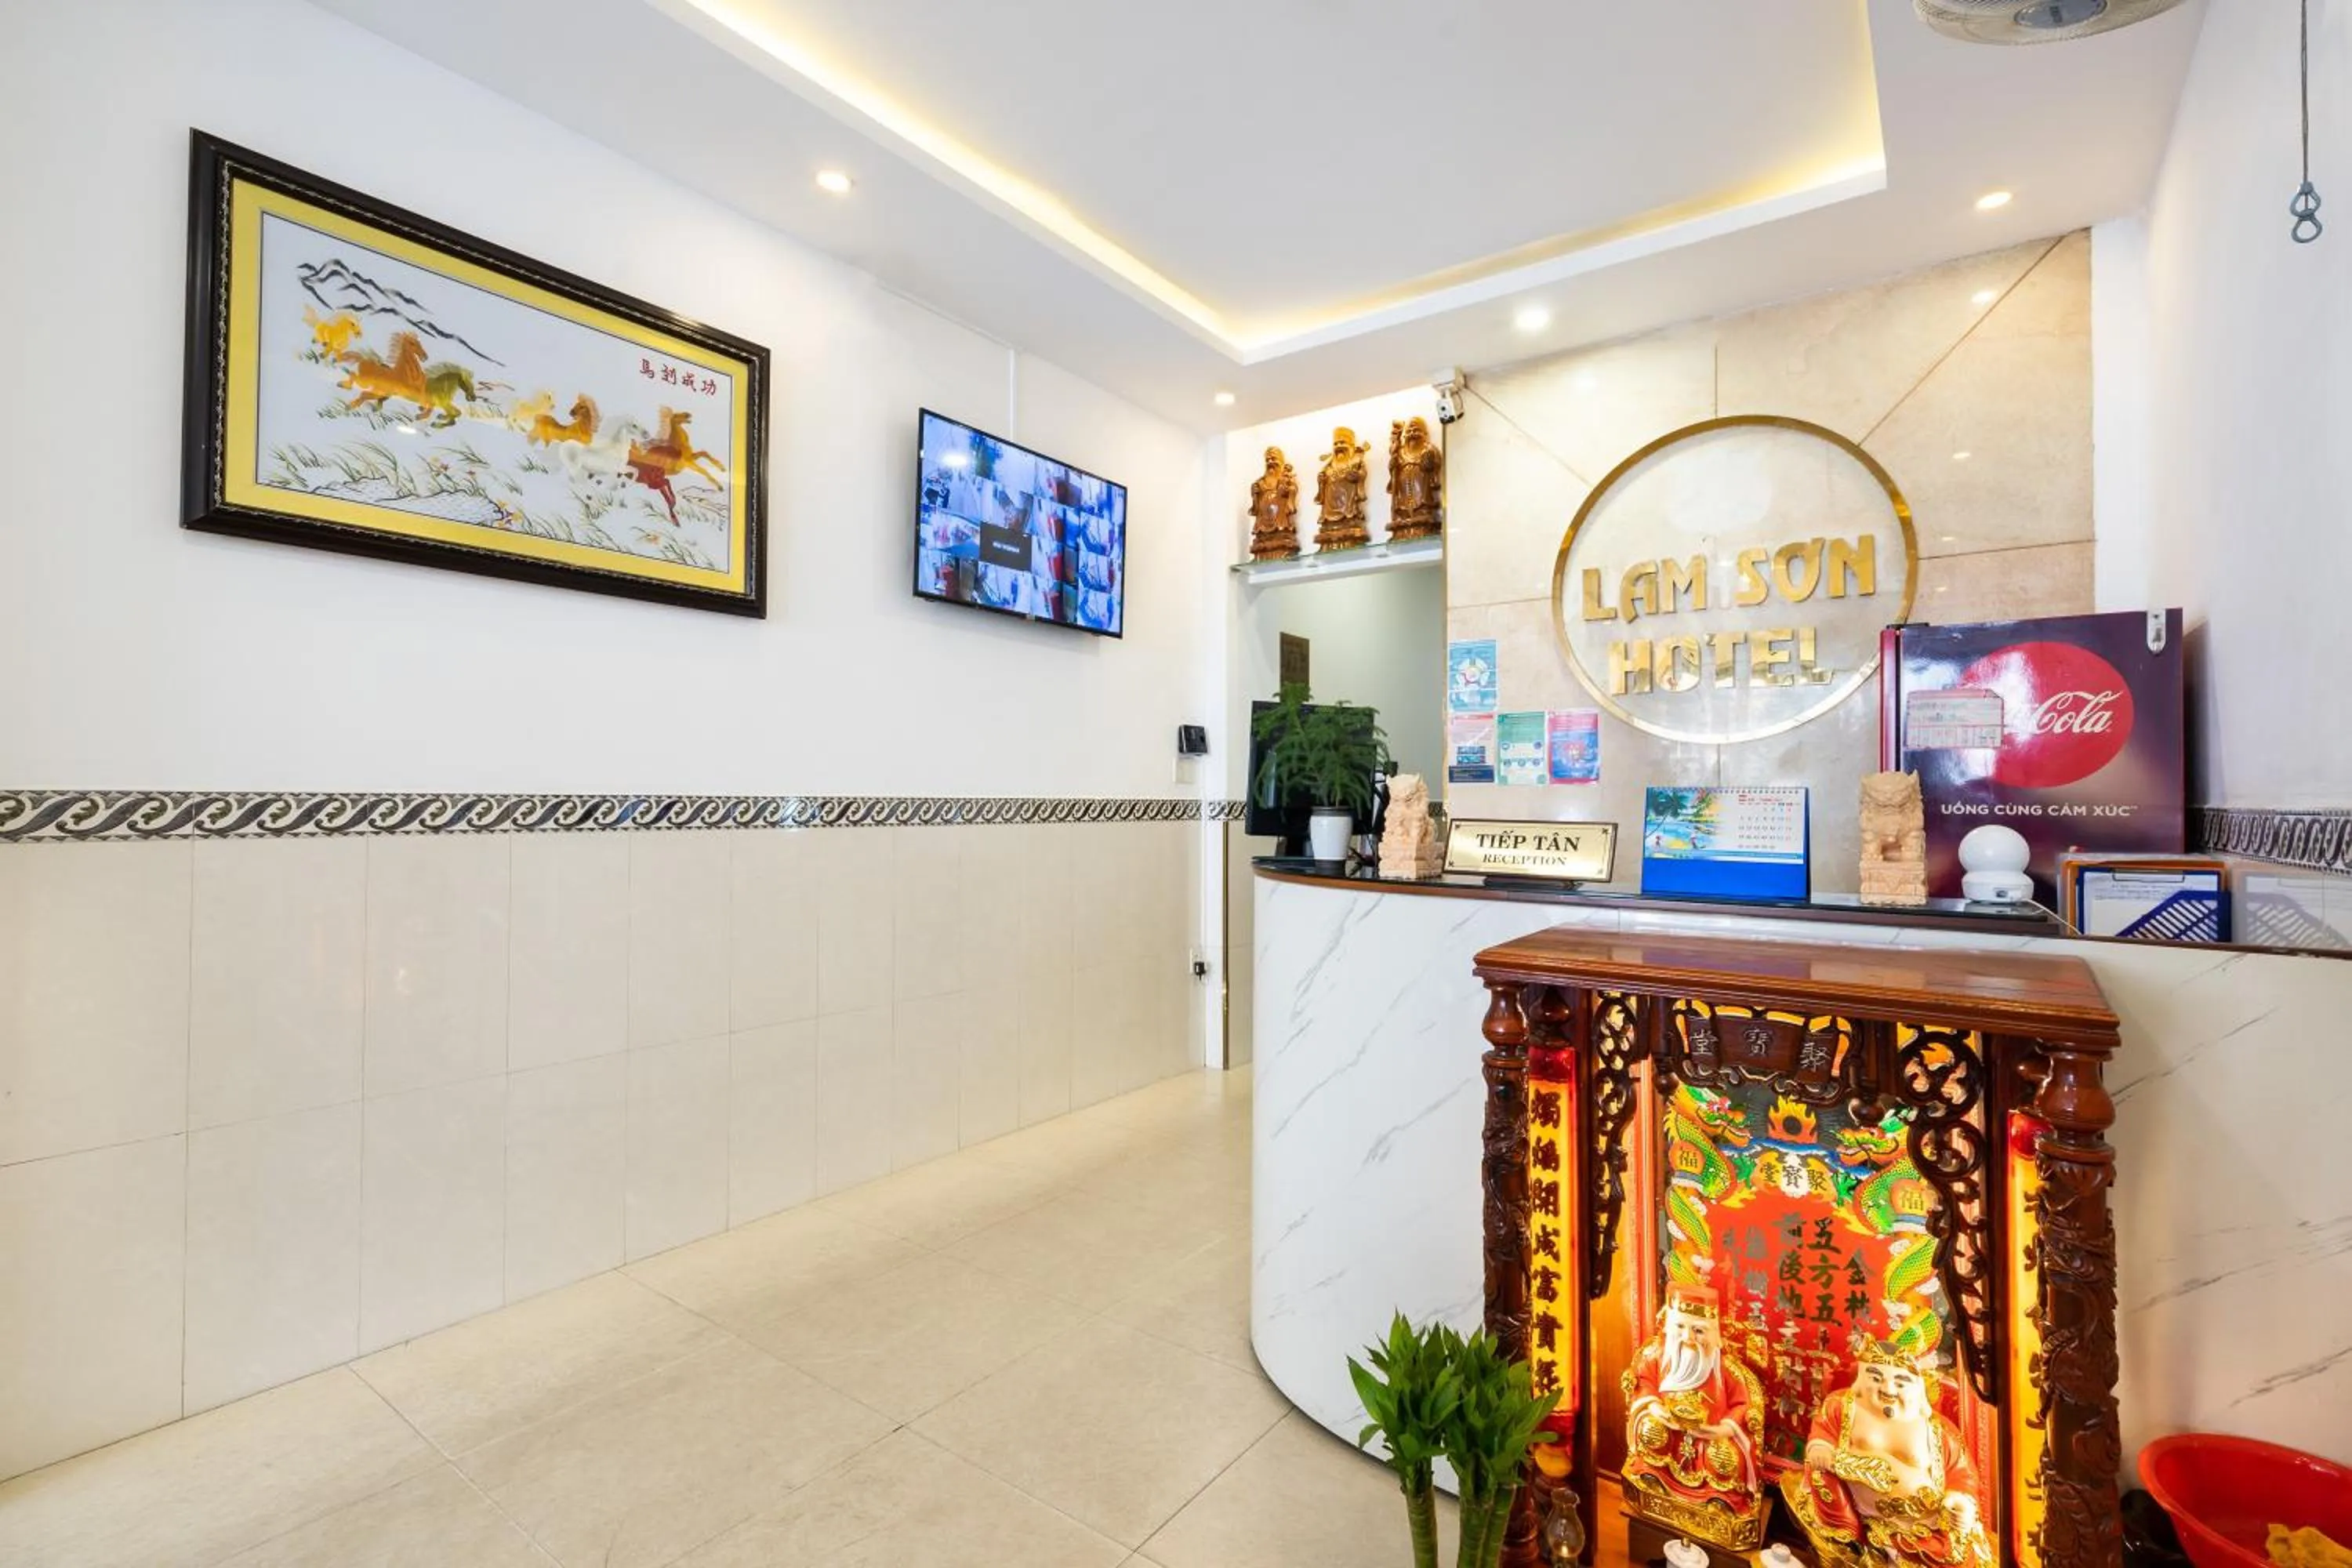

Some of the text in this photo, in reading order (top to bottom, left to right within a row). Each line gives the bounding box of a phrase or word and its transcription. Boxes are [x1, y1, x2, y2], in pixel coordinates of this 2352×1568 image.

[639, 358, 717, 397] 馬到成功
[1581, 534, 1878, 624] LAM SƠN
[1607, 627, 1836, 697] HOTEL
[1476, 830, 1581, 852] TIẾP TÂN
[1483, 854, 1567, 866] RECEPTION
